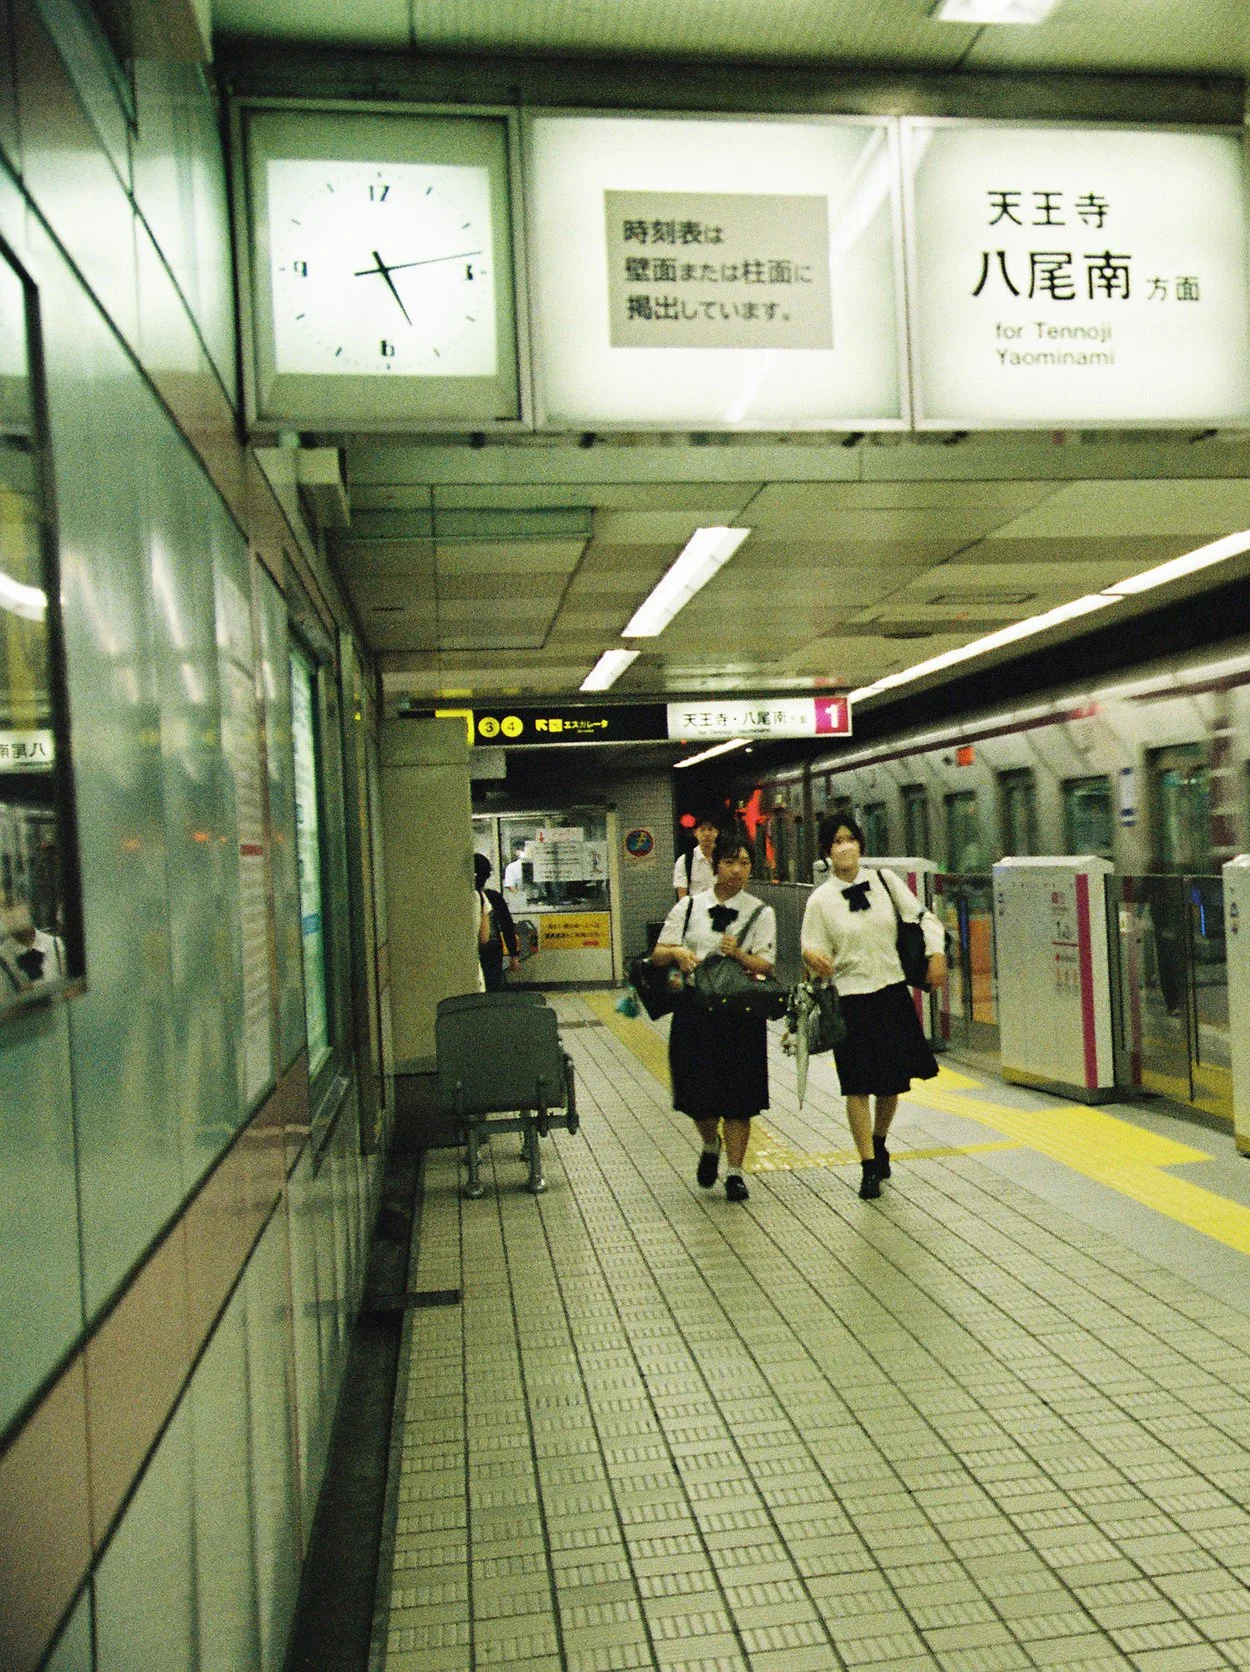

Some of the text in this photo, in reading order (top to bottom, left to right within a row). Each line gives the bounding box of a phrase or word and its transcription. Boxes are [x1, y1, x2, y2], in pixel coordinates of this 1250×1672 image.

[987, 191, 1110, 229] 天王寺
[623, 218, 724, 245] 時刻表は
[294, 261, 308, 278] 9
[625, 256, 813, 284] 壁面または柱面に
[972, 250, 1200, 302] 八尾南 方面
[627, 294, 790, 320] 掲出しています。
[995, 321, 1113, 344] for Tennoji
[380, 339, 396, 357] 6
[996, 348, 1116, 366] Yaominami
[484, 721, 494, 733] 3
[507, 720, 516, 732] 4
[683, 710, 787, 728] 天王寺・八尾南
[824, 704, 839, 729] 1
